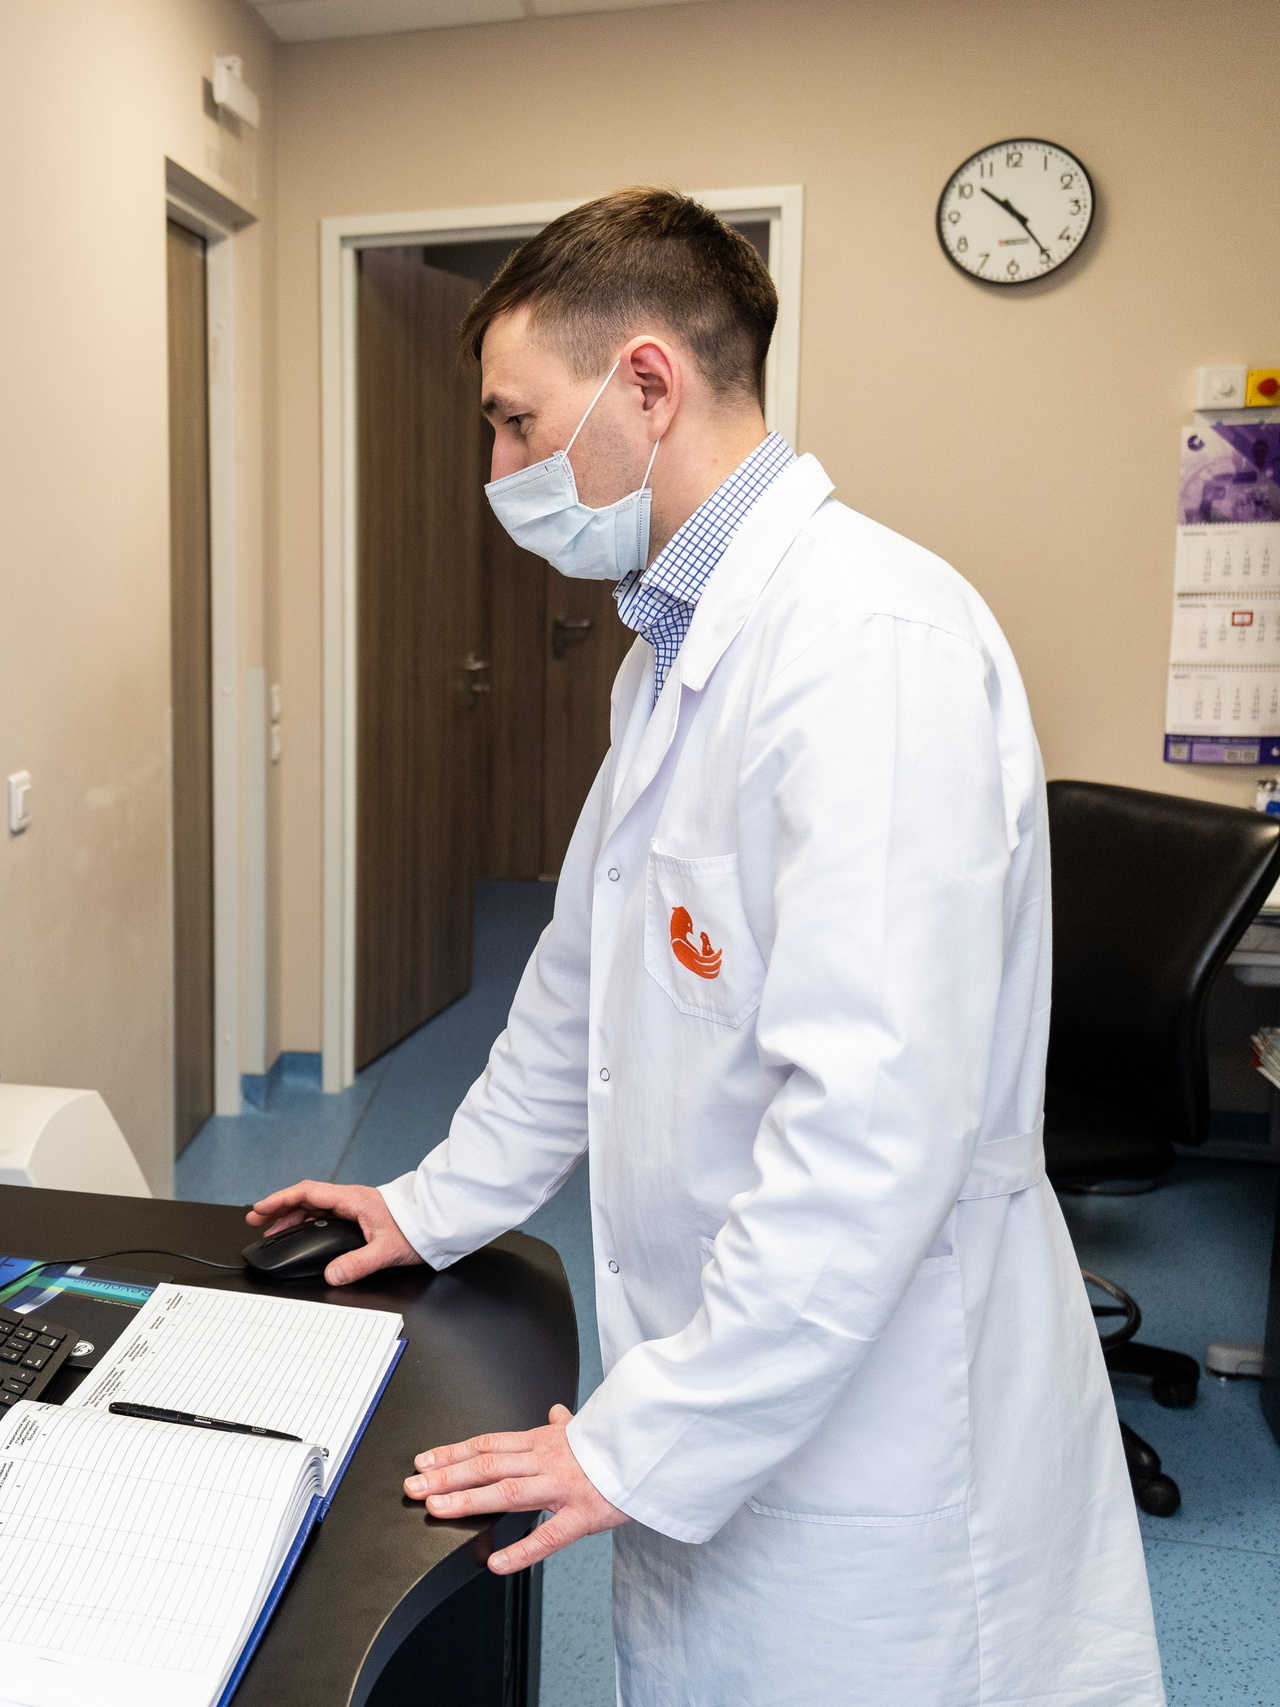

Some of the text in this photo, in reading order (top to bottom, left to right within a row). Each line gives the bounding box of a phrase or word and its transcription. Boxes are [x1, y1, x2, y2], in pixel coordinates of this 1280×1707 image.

[1006, 152, 1023, 168] 12
[1044, 156, 1047, 171] 1
[980, 162, 993, 178] 11
[1061, 174, 1074, 190] 2
[958, 183, 973, 199] 10
[1070, 200, 1081, 216] 3
[949, 211, 961, 226] 9
[1058, 227, 1070, 241] 4
[957, 236, 968, 252] 8
[979, 253, 990, 269] 7
[1006, 260, 1019, 275] 6
[74, 1279, 151, 1297] Revolution
